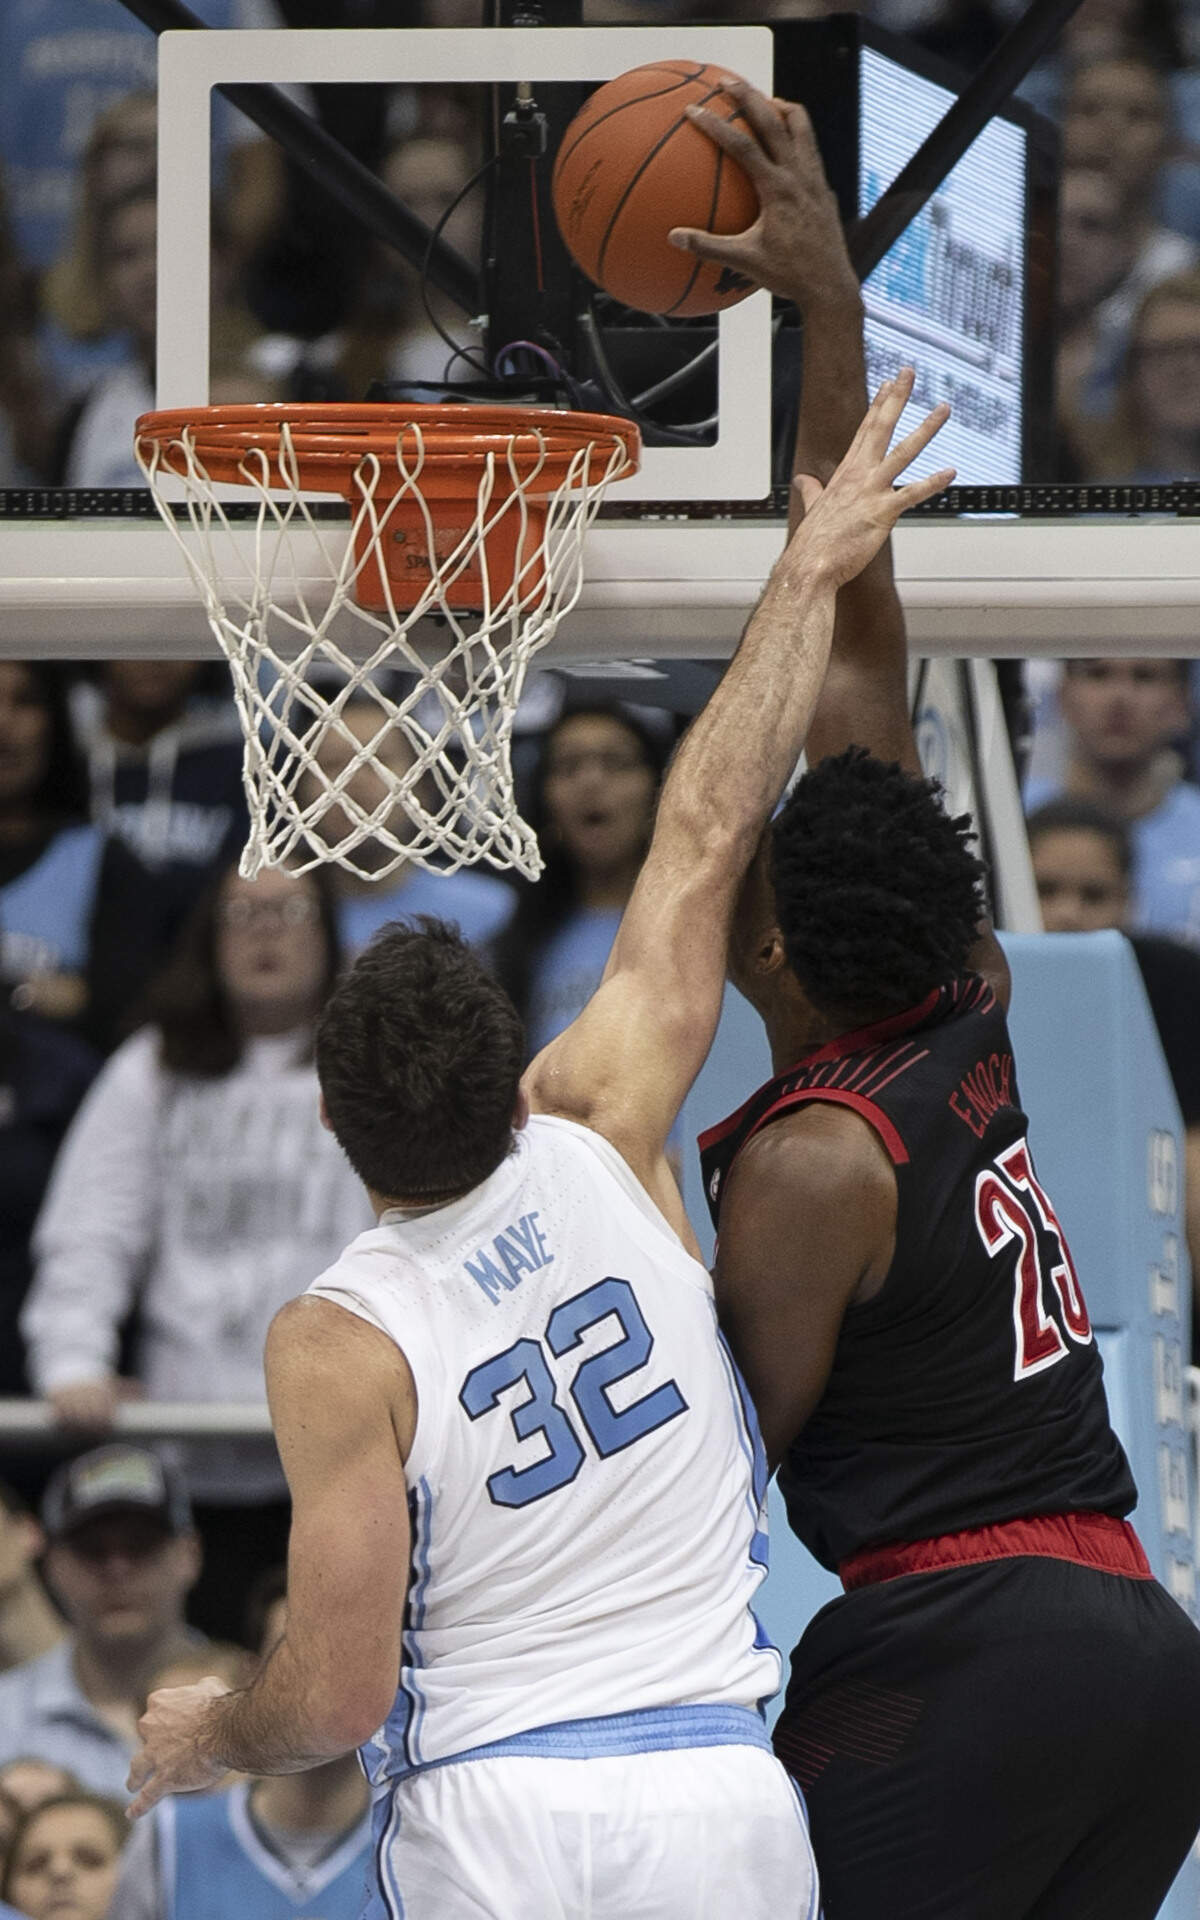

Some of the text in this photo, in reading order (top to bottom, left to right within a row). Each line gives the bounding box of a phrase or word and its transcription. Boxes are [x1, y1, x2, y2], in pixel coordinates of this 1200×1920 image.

[949, 1053, 1014, 1139] ENOCH
[463, 1211, 554, 1306] MAYE
[458, 1276, 690, 1509] 32
